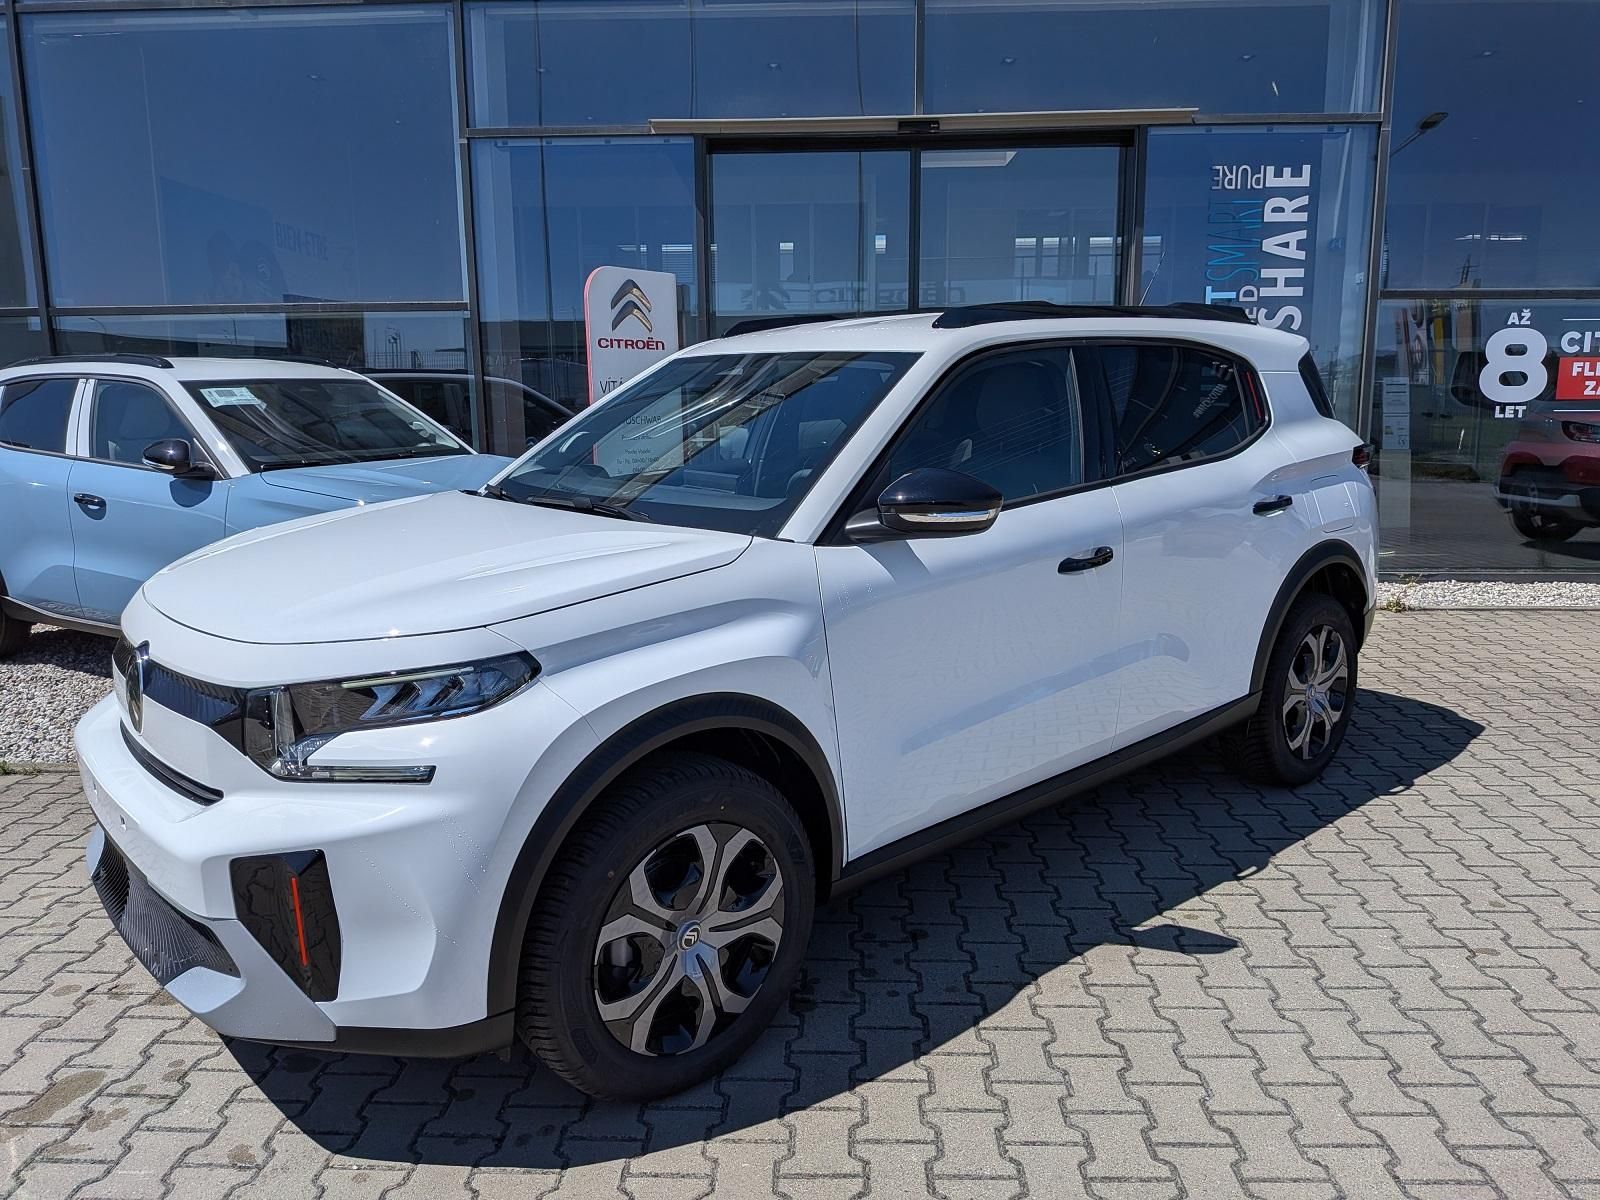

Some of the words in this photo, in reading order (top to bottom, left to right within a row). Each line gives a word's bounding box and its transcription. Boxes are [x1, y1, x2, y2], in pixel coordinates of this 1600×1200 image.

[1211, 164, 1264, 190] PURE
[1256, 164, 1312, 331] SHARE
[1507, 308, 1532, 325] AŽ
[597, 336, 665, 351] CITROËN
[1479, 327, 1548, 403] 8
[600, 376, 624, 394] VÍT
[1583, 380, 1600, 396] Z
[1494, 405, 1527, 418] LET
